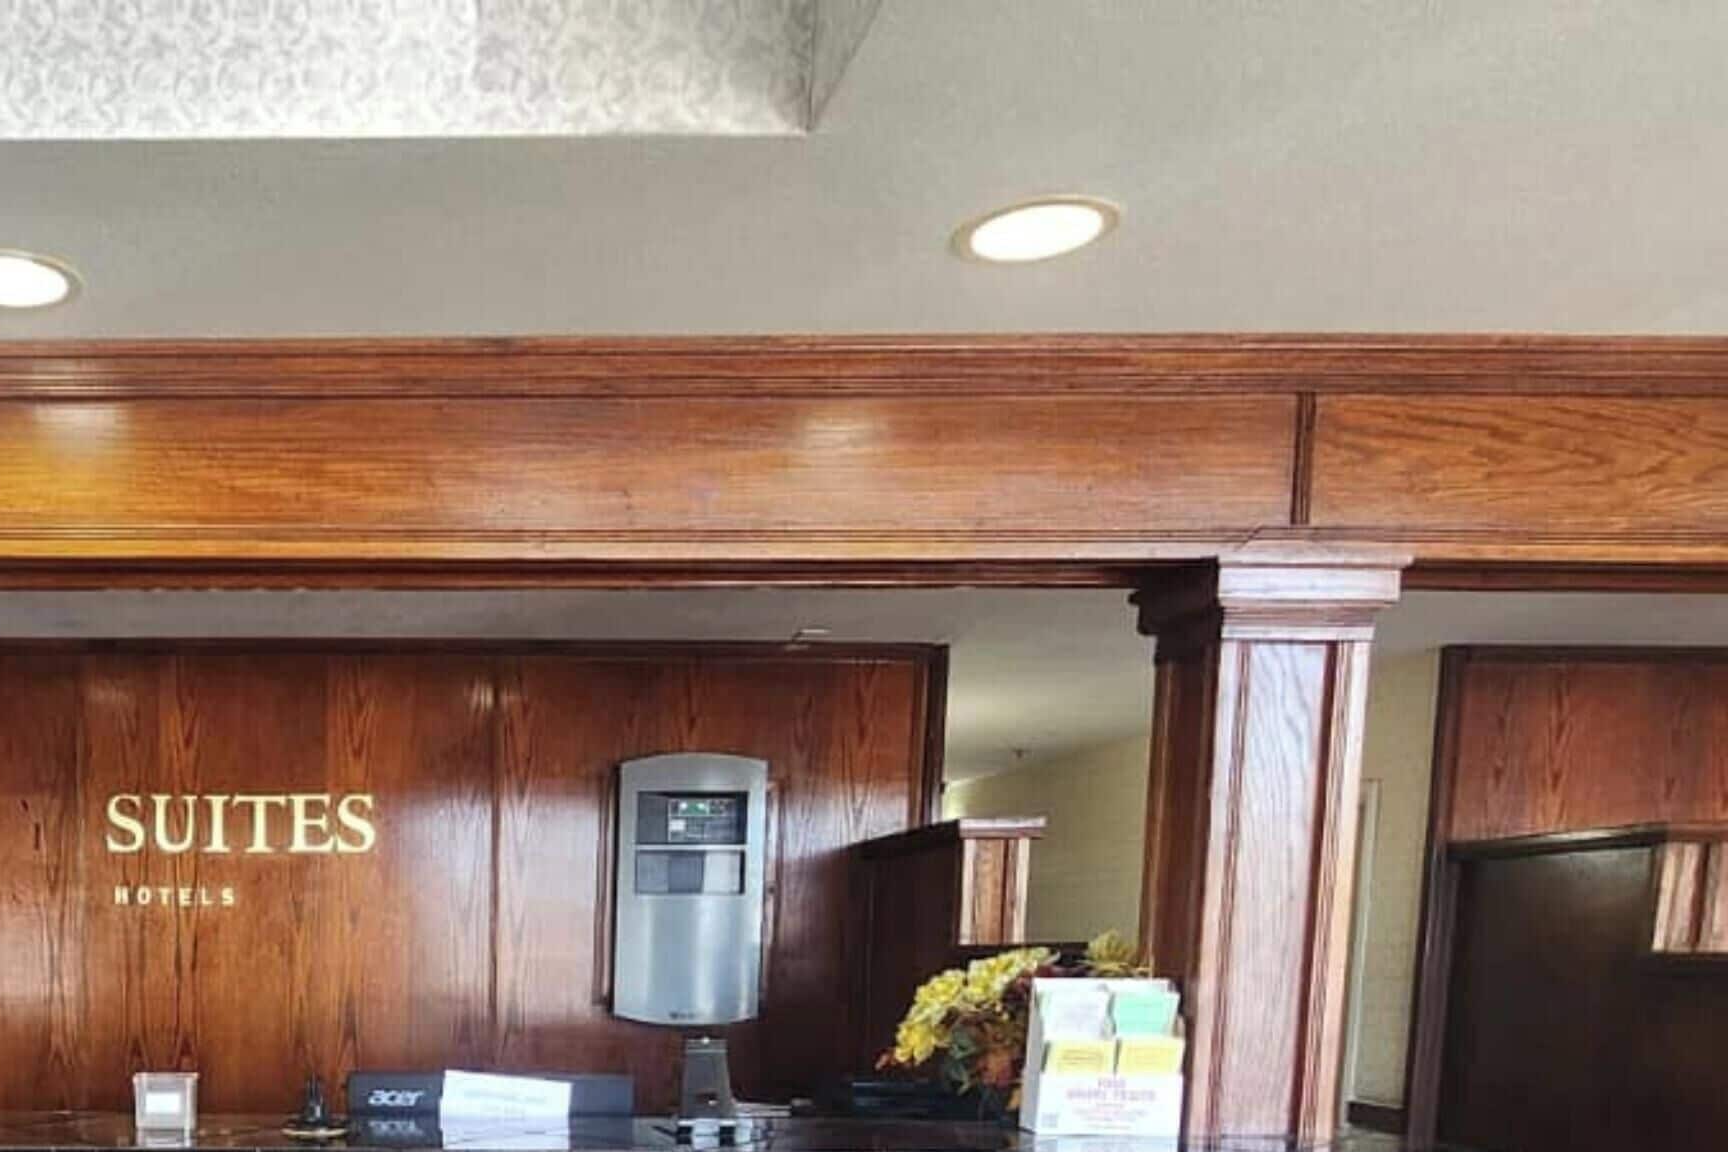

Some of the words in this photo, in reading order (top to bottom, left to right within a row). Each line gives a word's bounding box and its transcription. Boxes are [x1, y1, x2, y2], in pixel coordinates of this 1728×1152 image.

[106, 793, 376, 854] SUITES
[114, 885, 236, 906] HOTELS
[368, 1089, 425, 1107] acer
